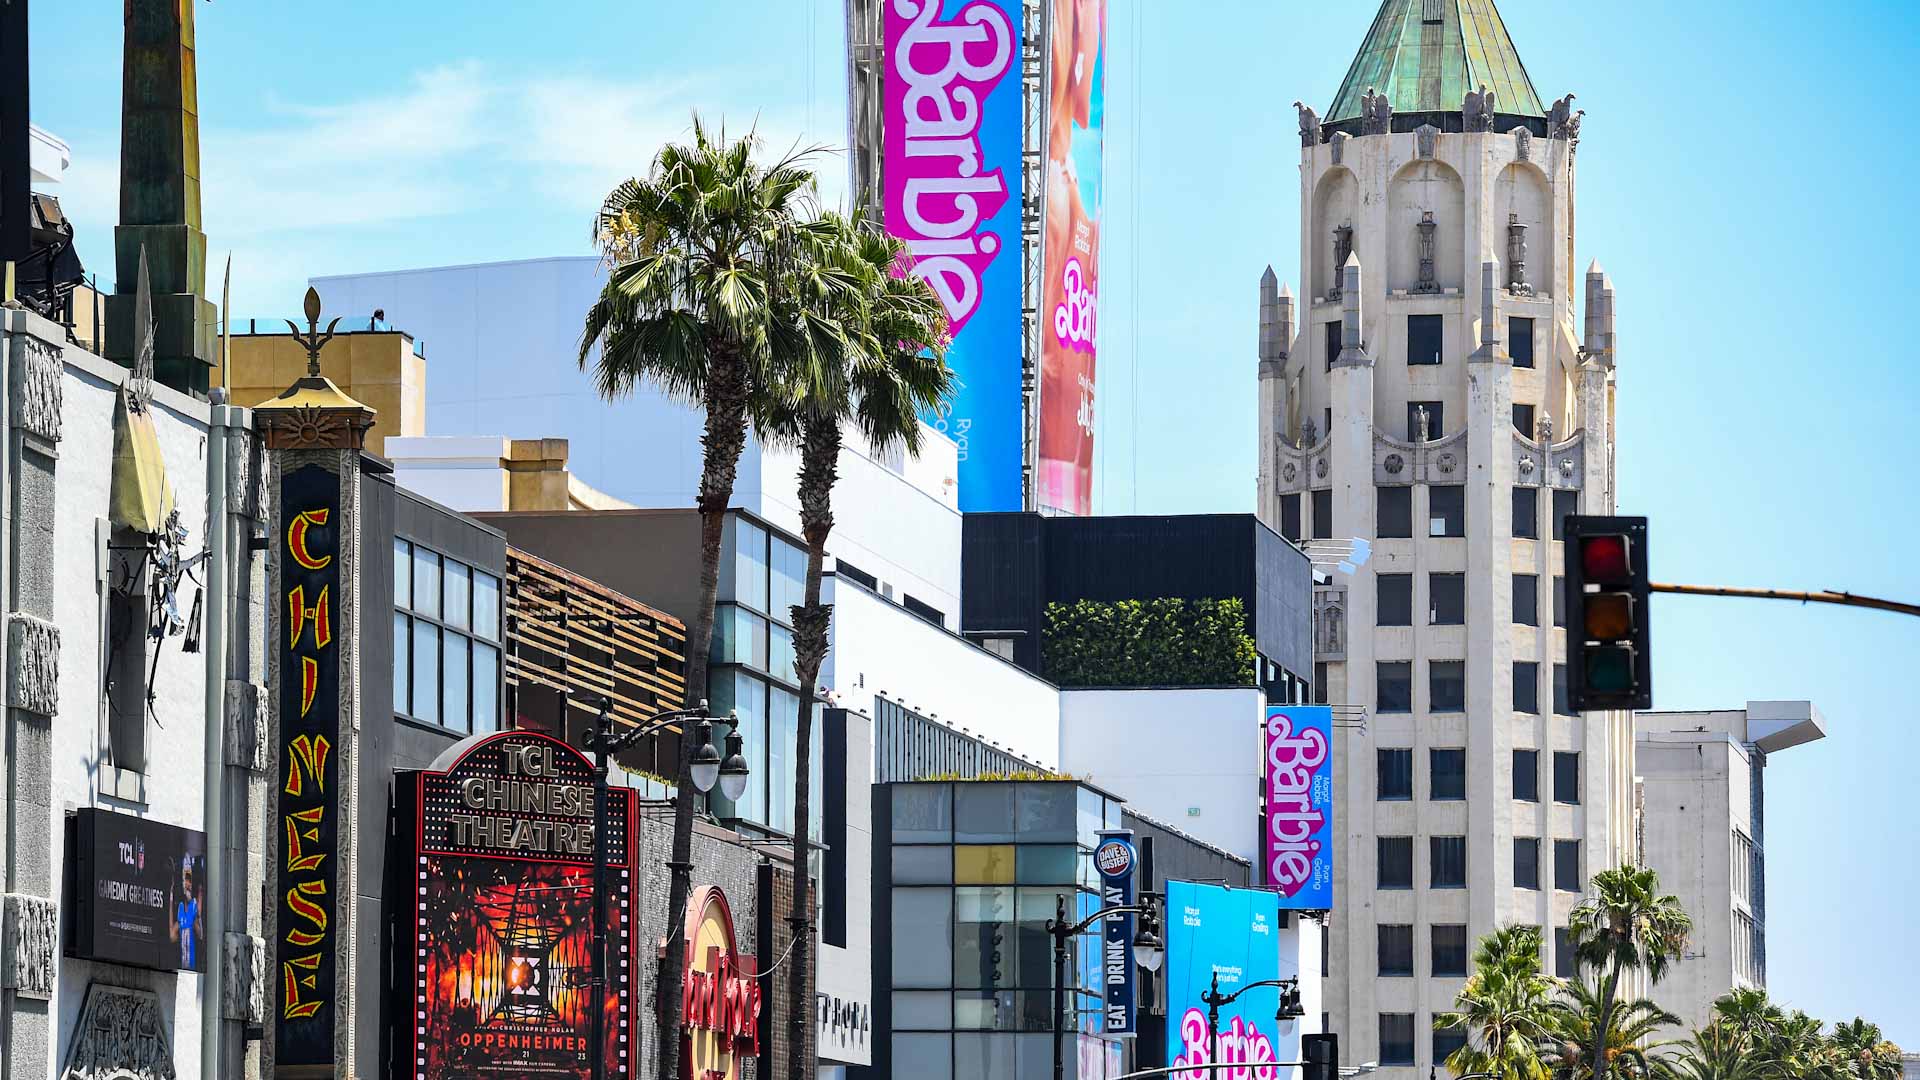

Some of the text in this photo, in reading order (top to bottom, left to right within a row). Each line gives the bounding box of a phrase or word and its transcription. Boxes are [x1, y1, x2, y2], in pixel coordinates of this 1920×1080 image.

[893, 0, 1011, 326] Barbie
[953, 418, 972, 462] Ryan
[284, 508, 332, 1021] CHINESE
[503, 743, 559, 777] TCL
[462, 778, 595, 817] CHINESE
[1268, 714, 1328, 886] Barbie
[452, 814, 595, 854] THEATRE
[118, 842, 135, 865] TCL
[98, 879, 164, 908] GAMEDAY GREATNESS
[1106, 939, 1125, 985] DRINK
[499, 1024, 548, 1033] CHRISTOPHER
[1108, 1003, 1127, 1029] EAT
[460, 1032, 587, 1051] OPPENHEIMER
[522, 1050, 530, 1058] 21
[577, 1052, 587, 1060] 23
